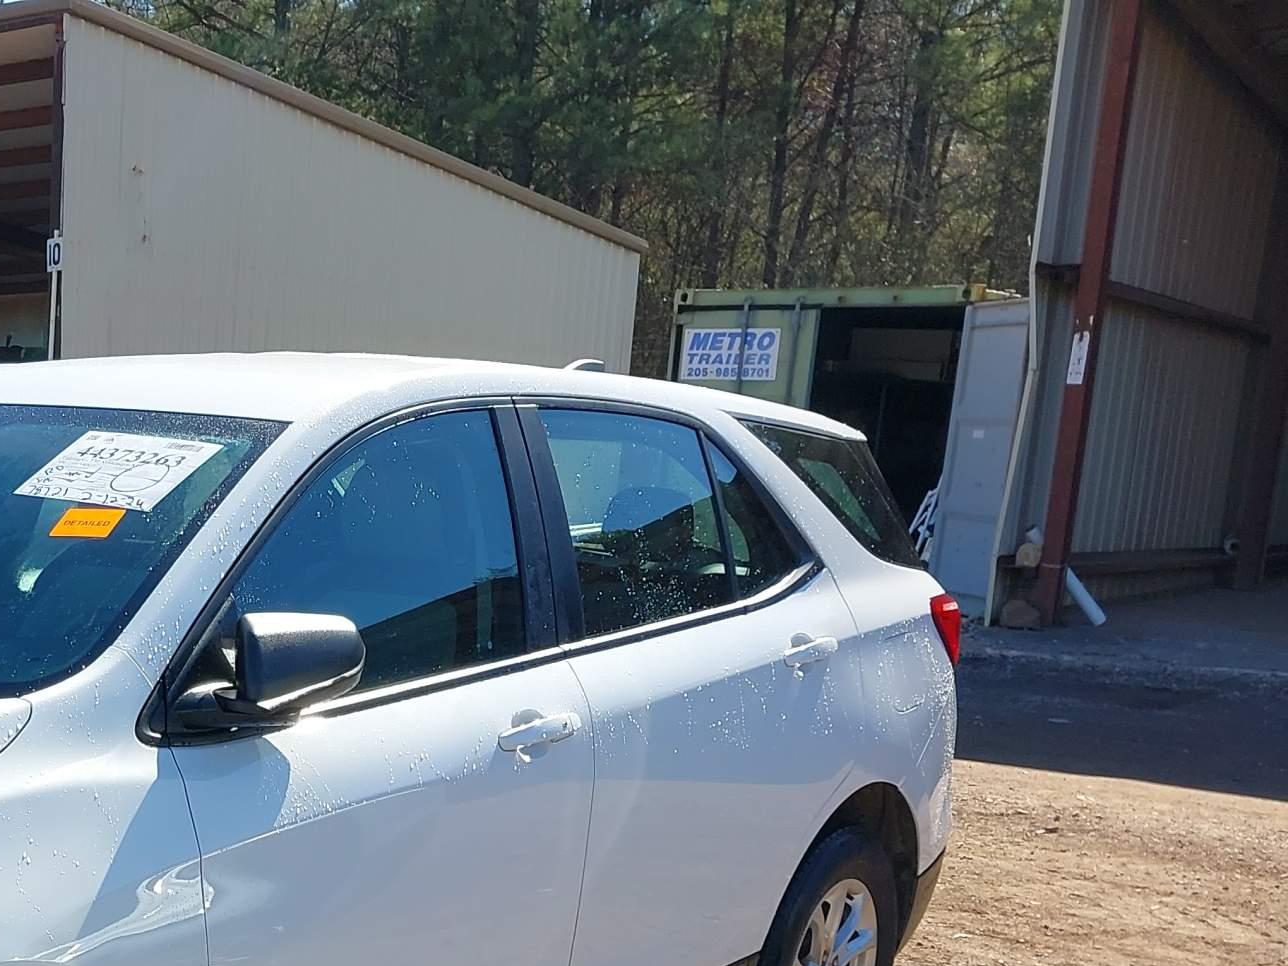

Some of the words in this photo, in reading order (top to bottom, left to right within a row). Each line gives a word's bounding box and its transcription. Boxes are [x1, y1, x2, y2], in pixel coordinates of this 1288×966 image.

[48, 242, 61, 267] 10
[688, 331, 776, 351] METRO
[687, 367, 770, 377] 205-9858701
[77, 446, 186, 468] 44373263
